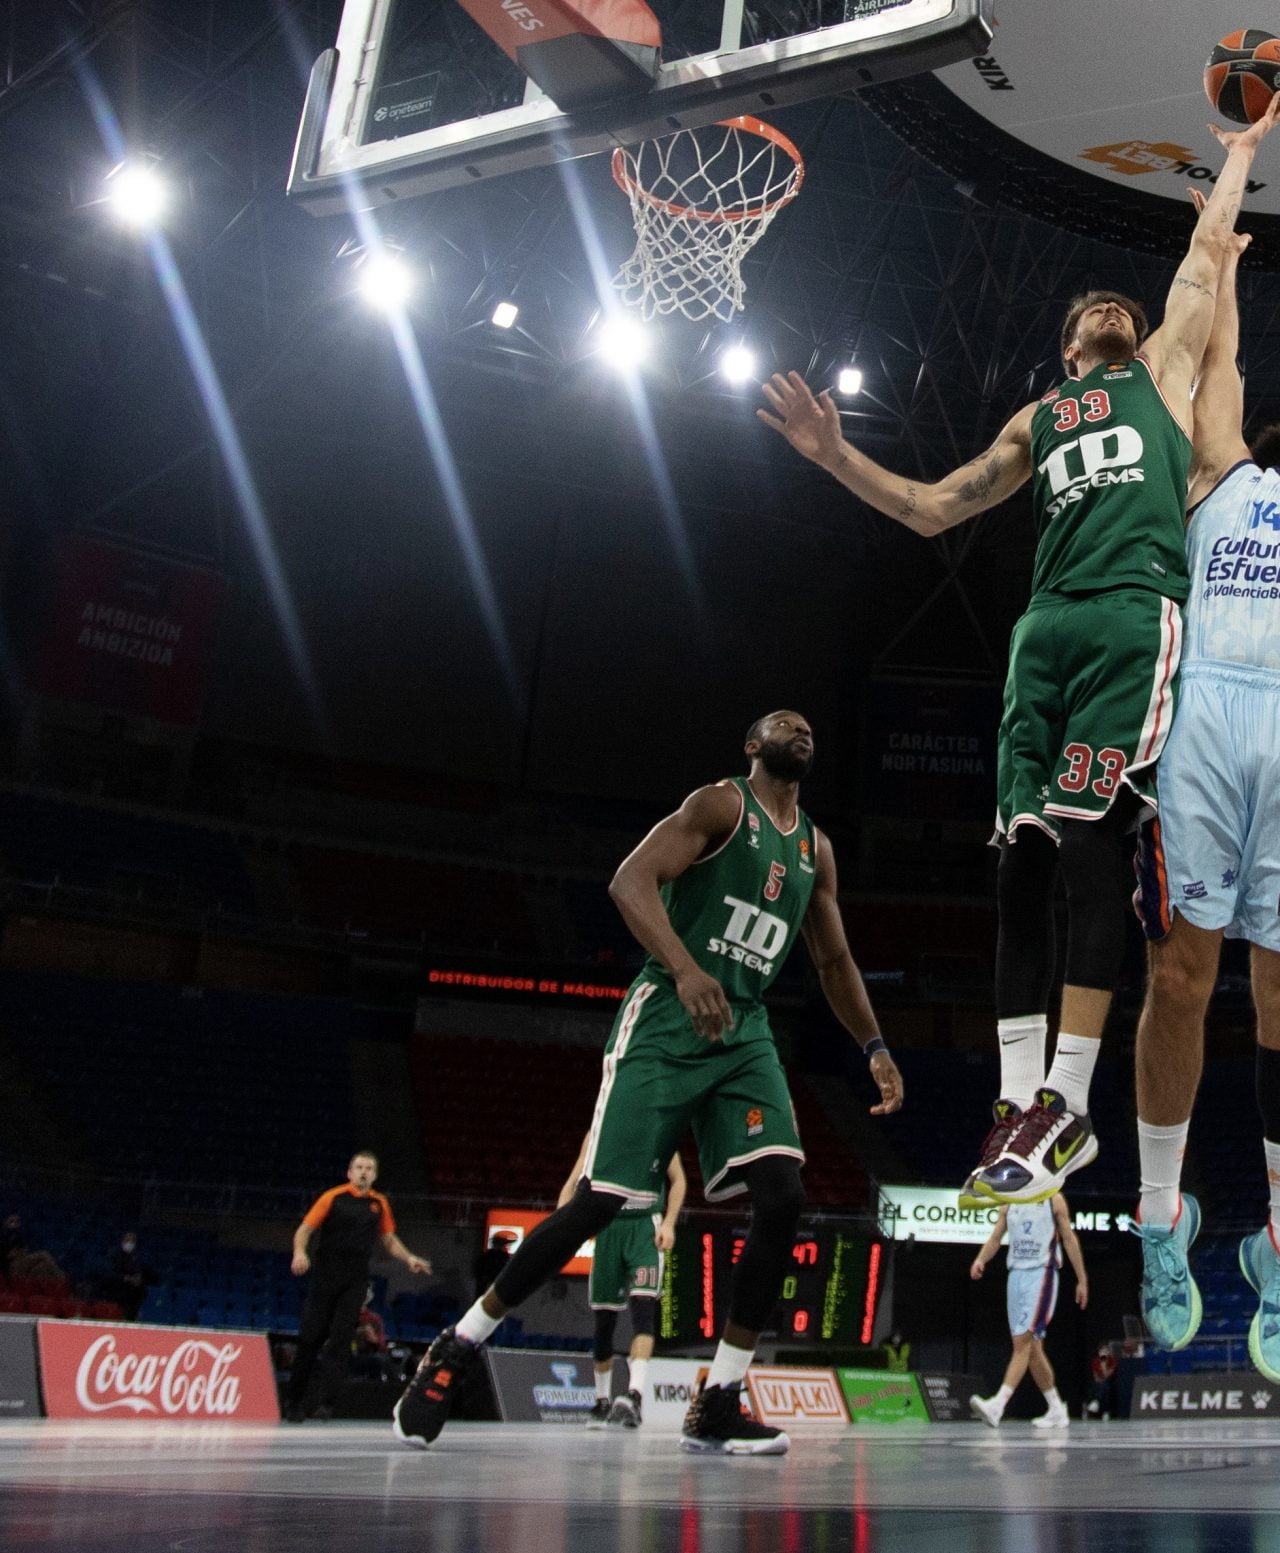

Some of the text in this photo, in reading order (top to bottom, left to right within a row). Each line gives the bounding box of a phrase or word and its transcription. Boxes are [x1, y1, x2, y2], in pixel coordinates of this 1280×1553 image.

[1053, 389, 1112, 432] 33
[1037, 425, 1144, 496] TD
[1057, 742, 1128, 799] 33
[763, 860, 786, 902] 5
[723, 894, 789, 961] TD
[706, 937, 775, 977] SYSTEMS
[428, 970, 534, 991] DISTRIBUIDOR
[539, 980, 558, 993] DE
[884, 1203, 908, 1220] EL
[634, 1267, 657, 1287] 31
[75, 1333, 244, 1414] Coca-Cola
[762, 1384, 837, 1409] VIALKI
[1140, 1390, 1244, 1411] KELME
